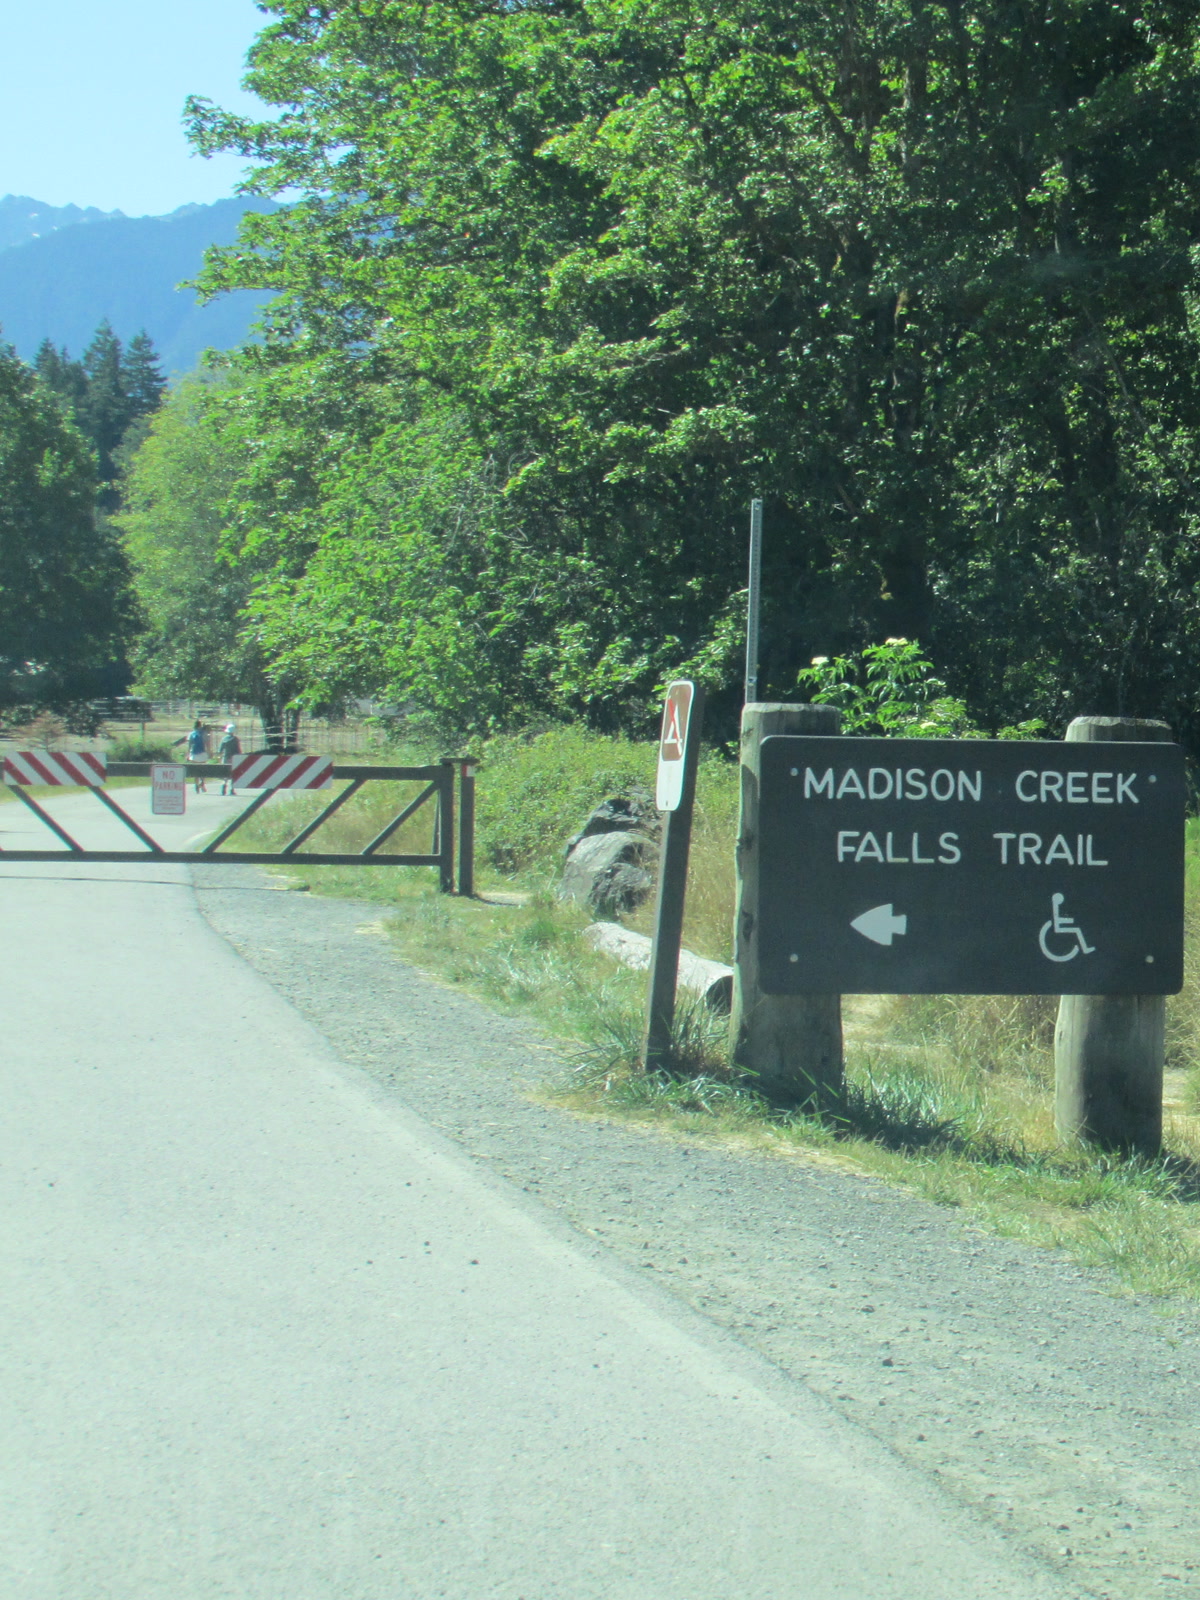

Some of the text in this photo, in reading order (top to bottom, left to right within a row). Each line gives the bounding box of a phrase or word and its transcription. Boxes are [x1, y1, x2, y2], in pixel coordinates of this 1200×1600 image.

[162, 770, 176, 780] NO
[803, 767, 1139, 804] MADISON CREEK
[154, 782, 183, 791] PARKING
[837, 831, 1108, 866] FALLS TRAIL
